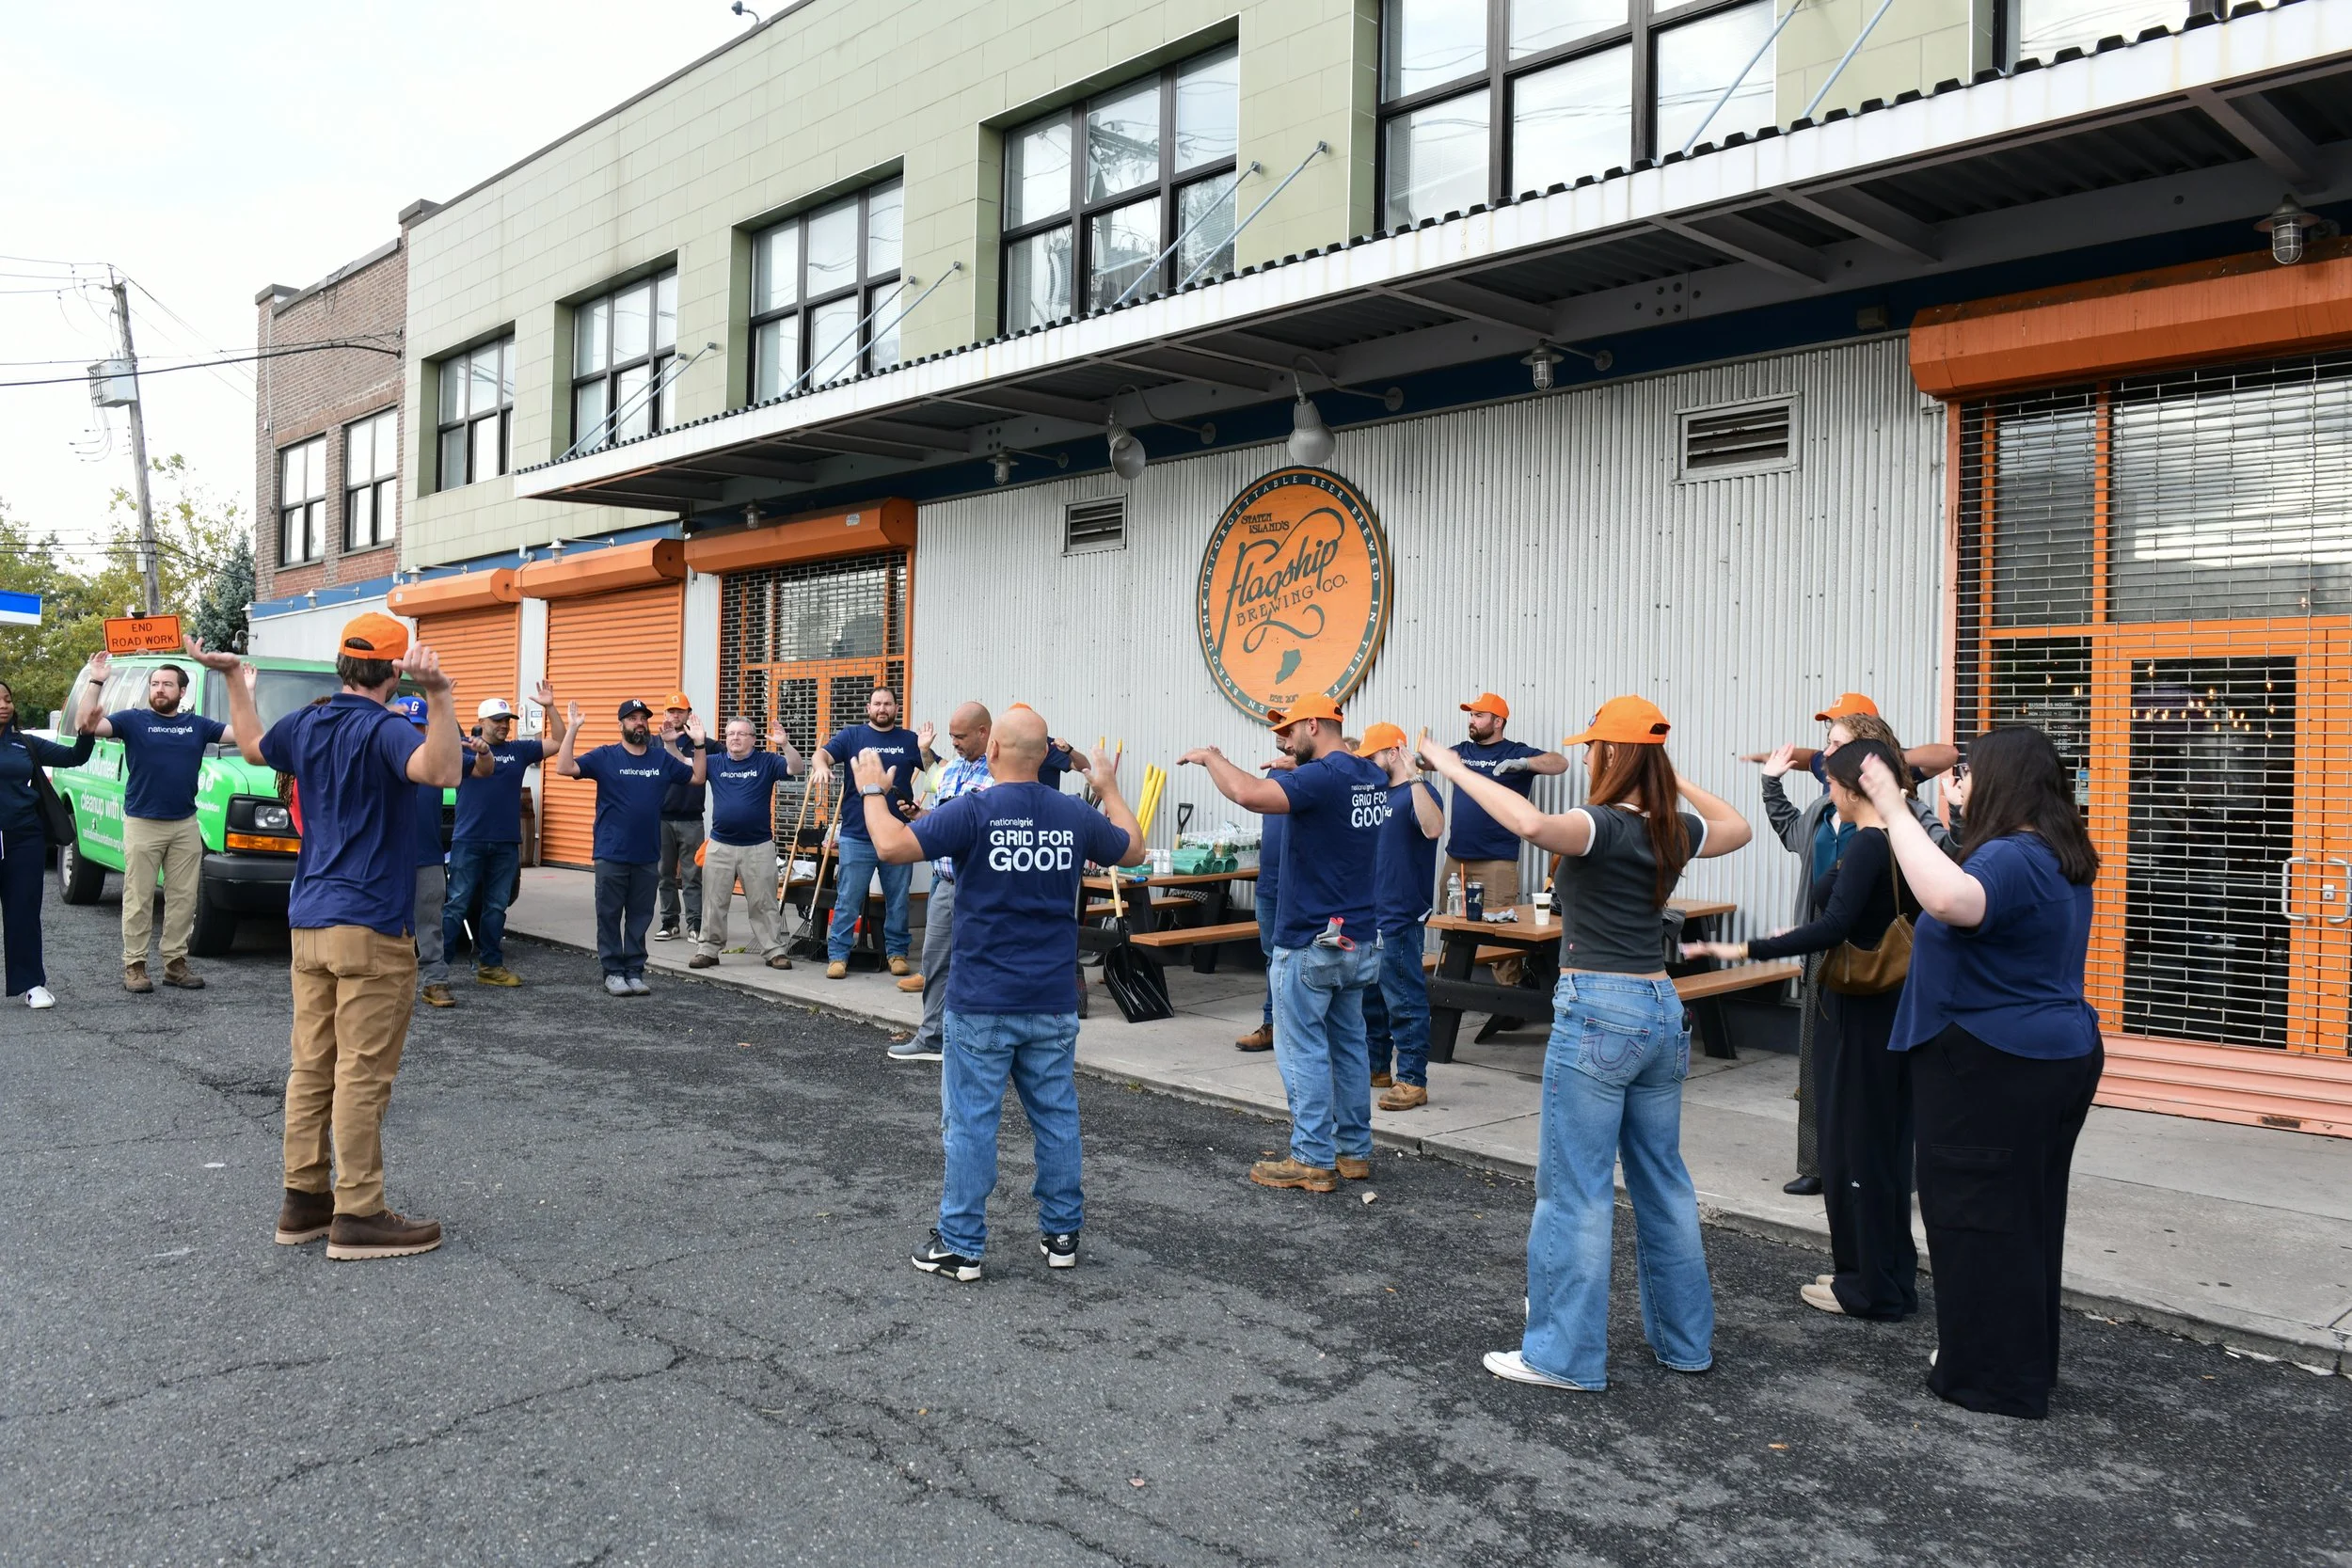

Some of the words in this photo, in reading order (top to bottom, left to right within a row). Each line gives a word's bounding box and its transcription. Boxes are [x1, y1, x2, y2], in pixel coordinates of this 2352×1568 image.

[1311, 476, 1343, 499] BEER
[1241, 513, 1272, 525] STATEN
[1203, 475, 1297, 590] UNFORGETTABLE
[1248, 520, 1290, 534] ISLAND'S
[1351, 506, 1380, 581] BREWED
[1236, 585, 1313, 627] BREWING
[1322, 574, 1348, 593] CO.
[1369, 600, 1379, 623] IN
[132, 622, 152, 633] END
[112, 637, 142, 648] ROAD
[145, 634, 175, 645] WORK
[1347, 640, 1369, 675] THE
[410, 701, 420, 712] G
[148, 725, 194, 736] nationalgrid
[88, 755, 119, 781] volunteer
[619, 768, 660, 778] nationalgrid
[721, 769, 757, 779] nationalgrid
[81, 788, 104, 821] cleanup
[104, 795, 119, 821] with
[1351, 793, 1372, 807] GRID
[989, 816, 1034, 829] nationalgrid
[989, 830, 1034, 847] GRID
[1038, 830, 1073, 847] FOR
[988, 847, 1073, 872] GOOD
